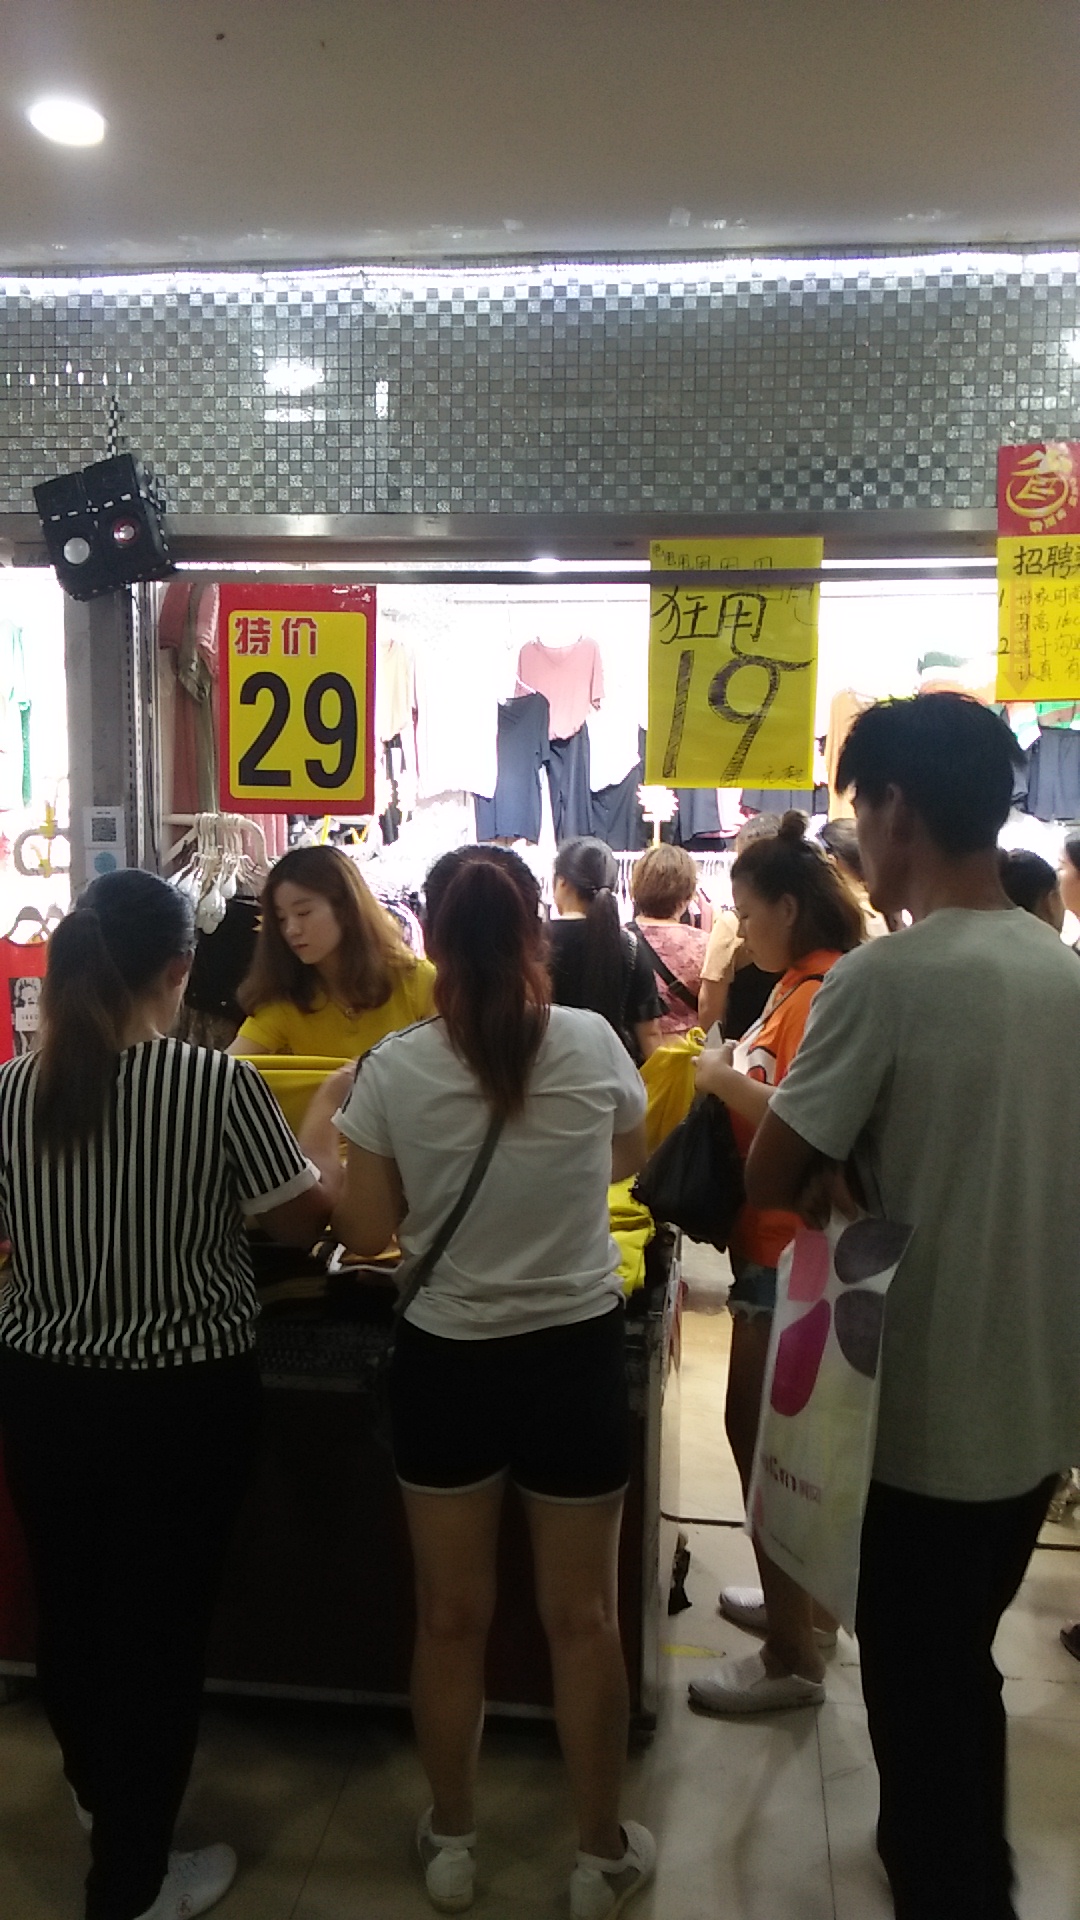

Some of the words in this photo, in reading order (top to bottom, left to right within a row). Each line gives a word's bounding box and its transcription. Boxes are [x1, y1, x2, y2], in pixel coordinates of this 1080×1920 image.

[234, 617, 318, 656] 特价
[238, 671, 357, 788] 29
[662, 649, 796, 788] 19
